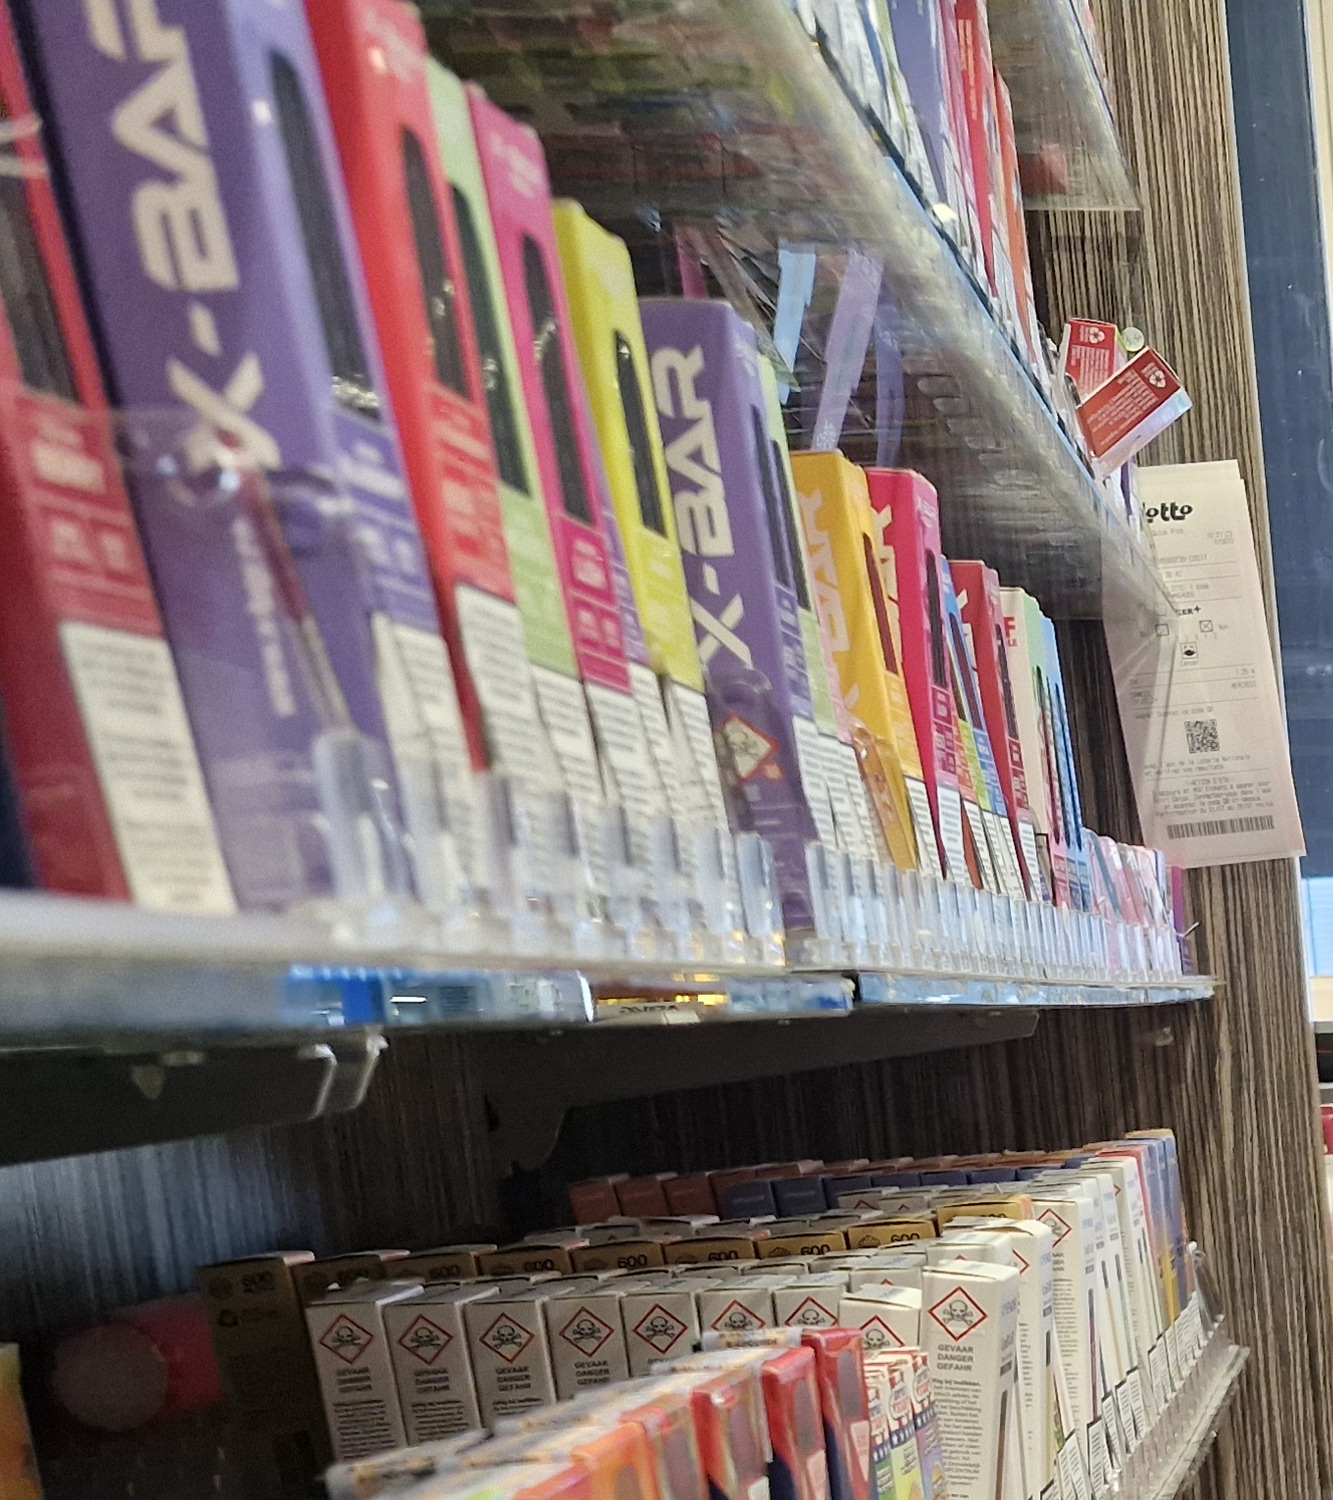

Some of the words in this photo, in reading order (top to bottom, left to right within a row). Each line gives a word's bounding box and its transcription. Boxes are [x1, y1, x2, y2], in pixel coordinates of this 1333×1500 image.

[650, 346, 756, 673] X-BAR
[1143, 502, 1193, 523] otto
[938, 1344, 974, 1354] GEVAAR
[937, 1353, 974, 1363] DANGER
[937, 1362, 973, 1372] GEFAHR
